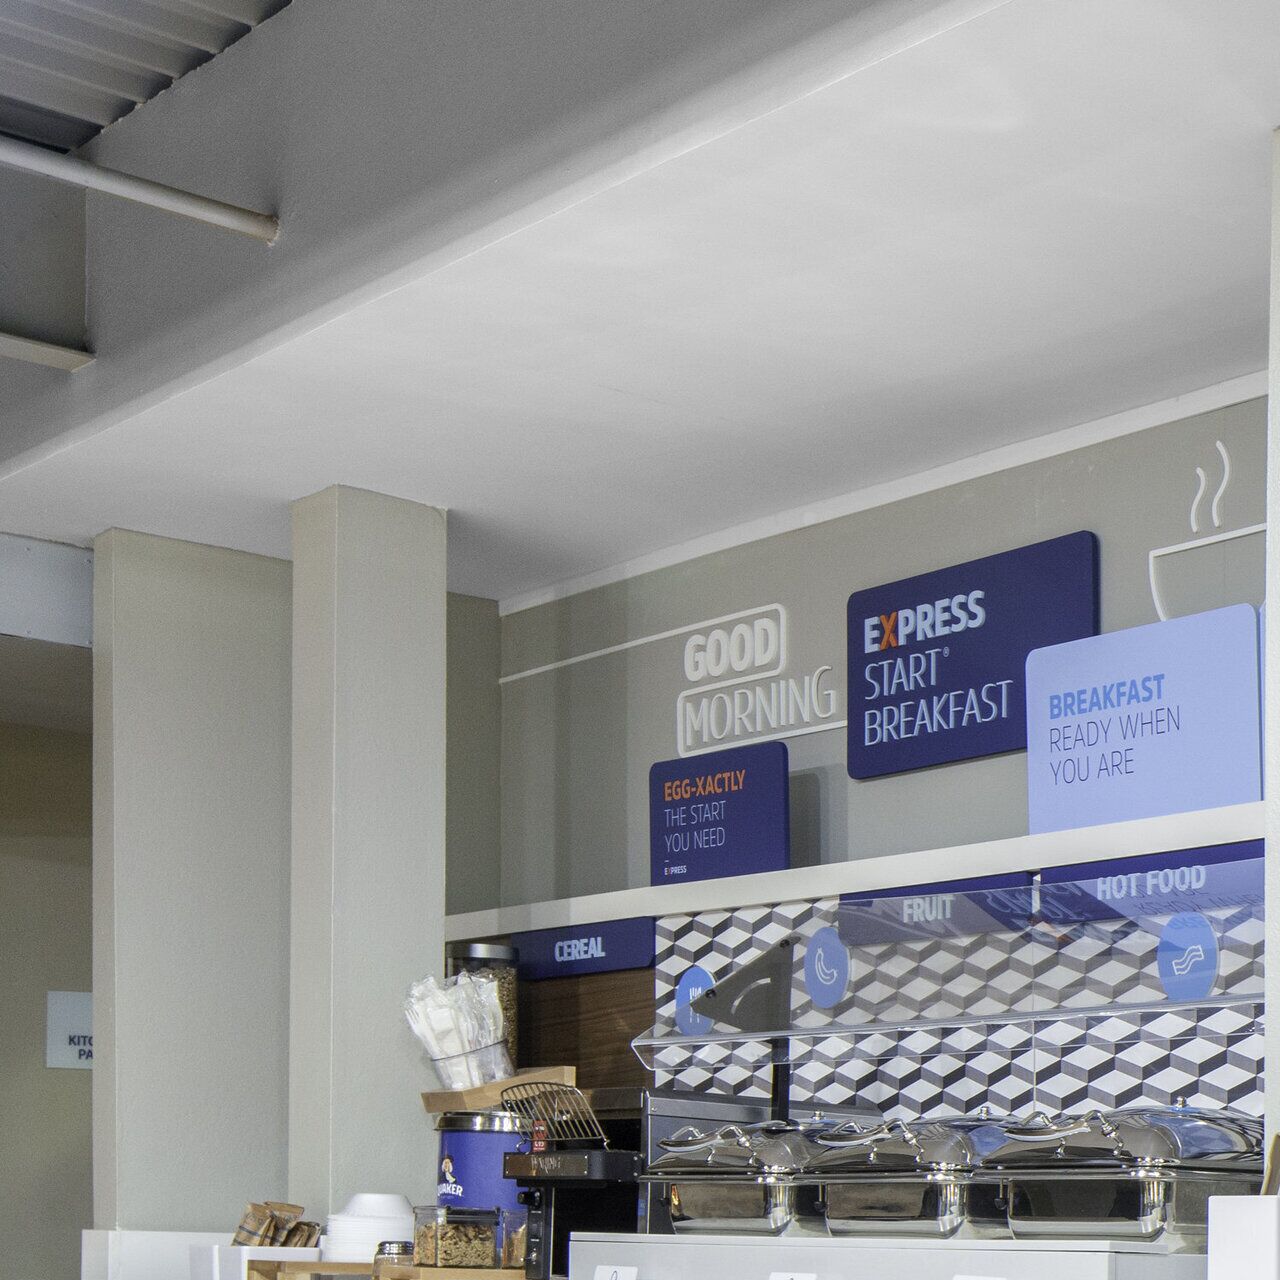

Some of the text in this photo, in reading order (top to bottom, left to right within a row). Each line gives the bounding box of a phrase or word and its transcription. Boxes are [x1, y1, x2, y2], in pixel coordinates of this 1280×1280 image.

[864, 590, 986, 654] EXPRESS
[684, 617, 777, 681] GOOD
[685, 665, 837, 747] MORNING
[864, 680, 1013, 747] BREAKFAST
[1049, 673, 1166, 719] BREAKFAST
[1049, 705, 1181, 752] READY WHEN
[664, 769, 746, 801] EGG-XACTLY
[1049, 748, 1135, 786] YOU ARE
[664, 800, 727, 827] THE START
[664, 827, 726, 852] YOU NEED
[664, 865, 688, 876] EXPRESS
[1097, 865, 1206, 900] HOT FOOD
[903, 894, 953, 924] FRUIT
[555, 937, 605, 962] CEREAL
